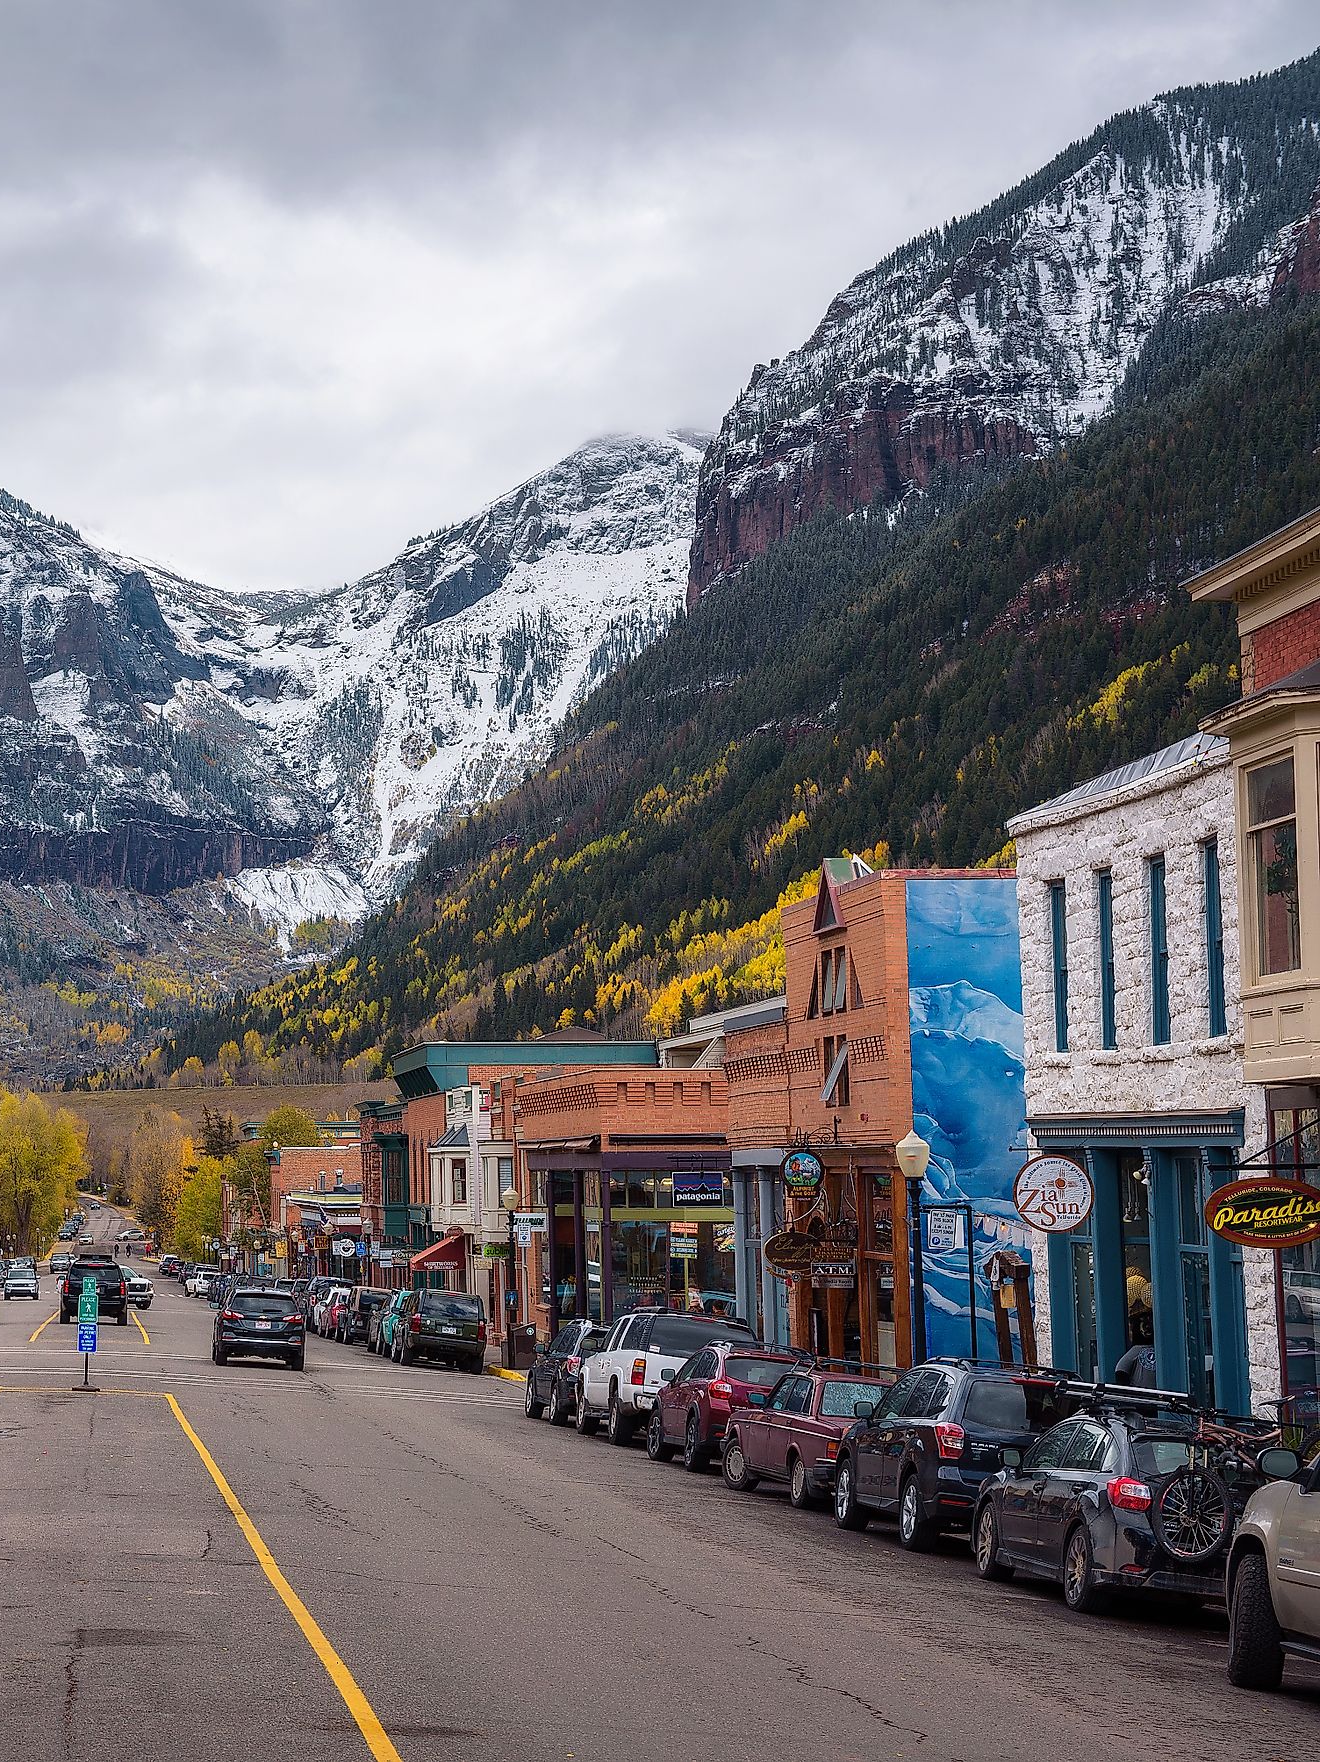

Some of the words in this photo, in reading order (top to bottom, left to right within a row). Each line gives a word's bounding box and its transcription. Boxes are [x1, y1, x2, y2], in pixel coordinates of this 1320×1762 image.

[676, 1193, 720, 1201] patagonia
[1018, 1184, 1058, 1213] Zia
[1224, 1187, 1258, 1203] TELLURIDE,
[1259, 1186, 1293, 1194] COLORADO
[1040, 1201, 1081, 1227] Sun
[1254, 1216, 1303, 1229] RESORTWEAR
